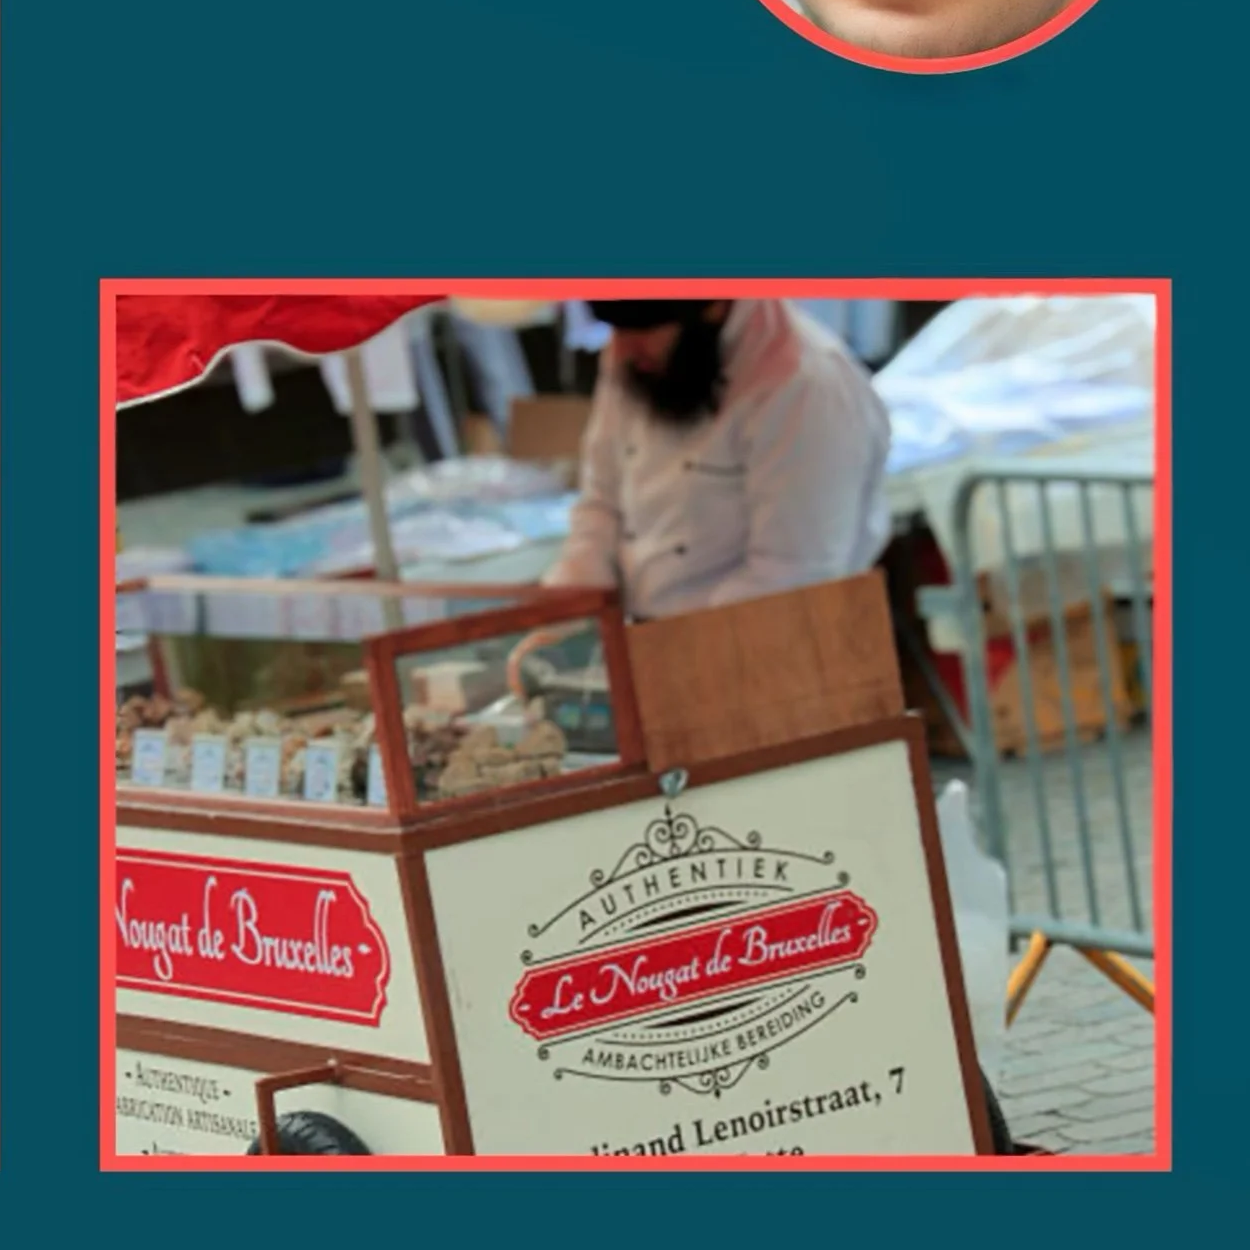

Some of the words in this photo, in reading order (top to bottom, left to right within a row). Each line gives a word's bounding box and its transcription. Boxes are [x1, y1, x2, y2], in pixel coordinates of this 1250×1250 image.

[197, 875, 225, 960] de
[229, 888, 354, 978] Bruxelles
[577, 856, 791, 932] AUTHENTIEK
[540, 974, 584, 1019] Le
[590, 954, 700, 1002] Nougat
[705, 926, 733, 977] de
[737, 900, 852, 966] Bruxelles
[581, 1042, 733, 1073] AMBACHTELIJKE
[736, 990, 827, 1051] BEREIDING
[135, 1059, 221, 1104] AUTHENTIQUE
[693, 1079, 883, 1147] Lenoirstraat,
[888, 1066, 907, 1095] 7
